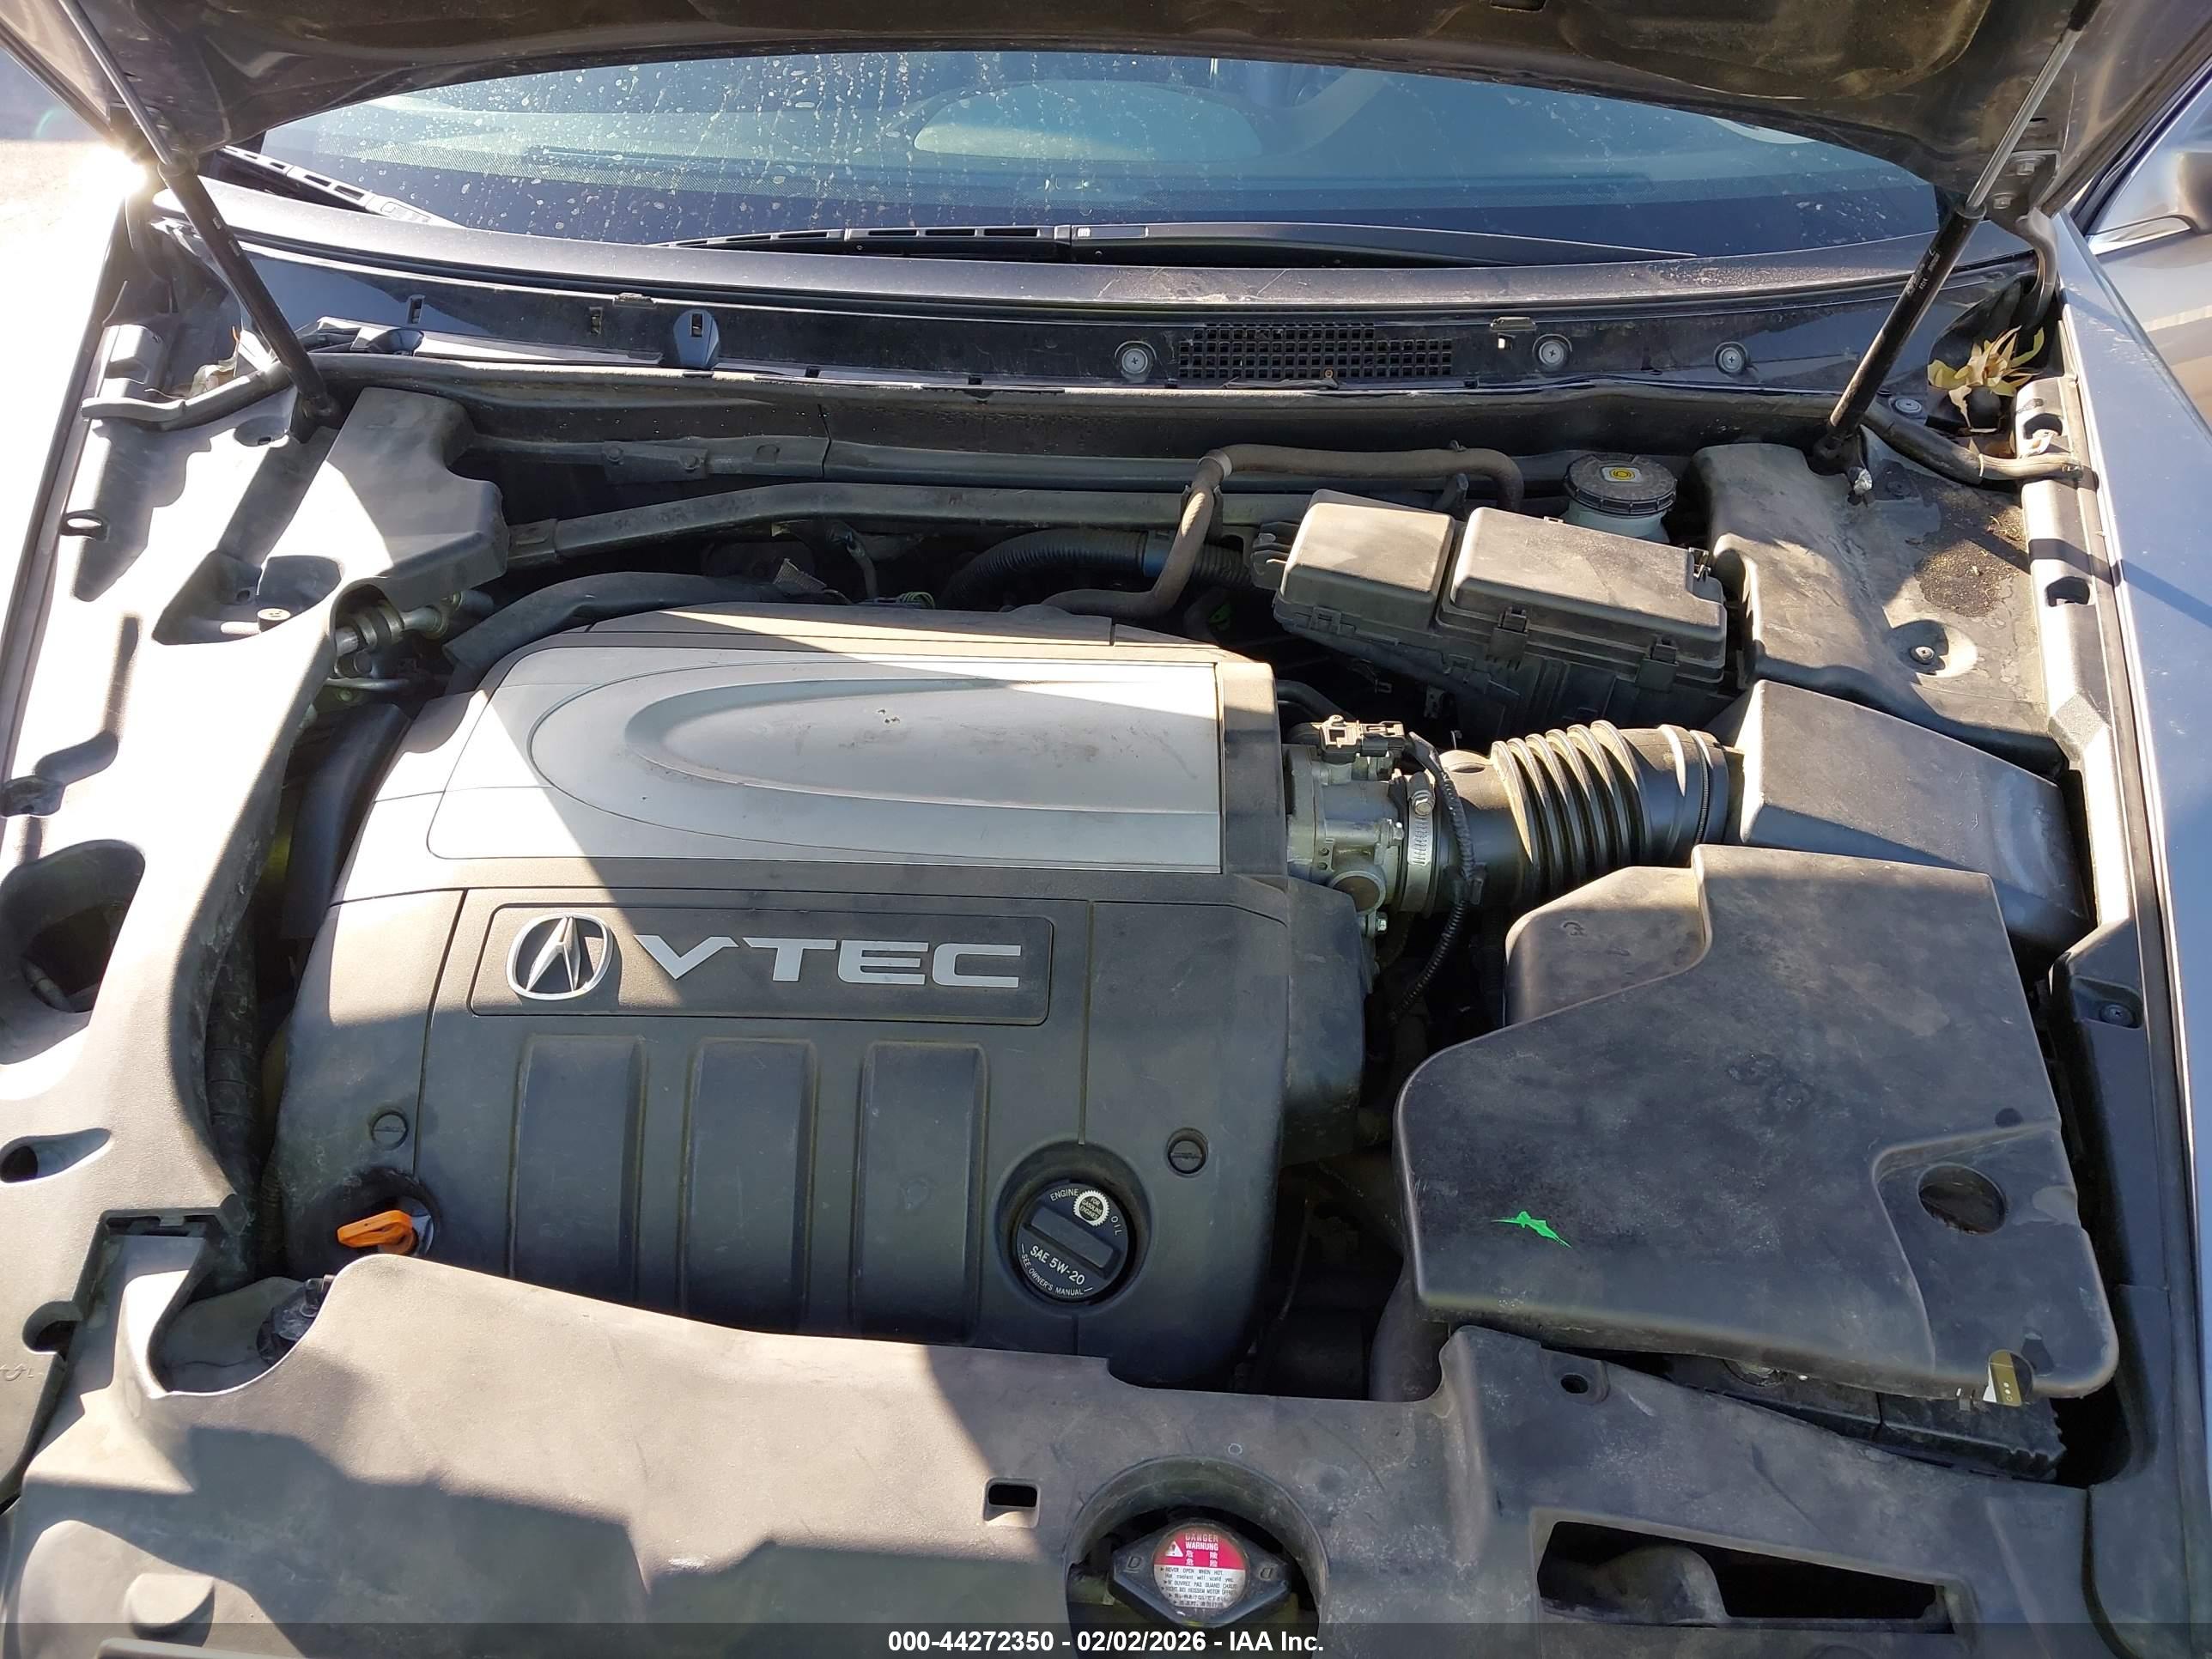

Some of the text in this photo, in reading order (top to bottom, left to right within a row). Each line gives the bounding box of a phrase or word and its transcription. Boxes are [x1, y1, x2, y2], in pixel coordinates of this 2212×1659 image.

[634, 933, 1022, 989] VTEC
[1081, 1200, 1103, 1216] GASOLINE
[1090, 1197, 1100, 1206] FOR
[1049, 1188, 1123, 1236] ENGINE OIL
[1079, 1206, 1099, 1219] ENGINES
[1030, 1245, 1085, 1285] SAE 5W-20
[1021, 1253, 1084, 1297] SEE OWNER'S MANUAL
[1185, 1532, 1218, 1542] DANGER
[1185, 1541, 1219, 1551] WARNUNG
